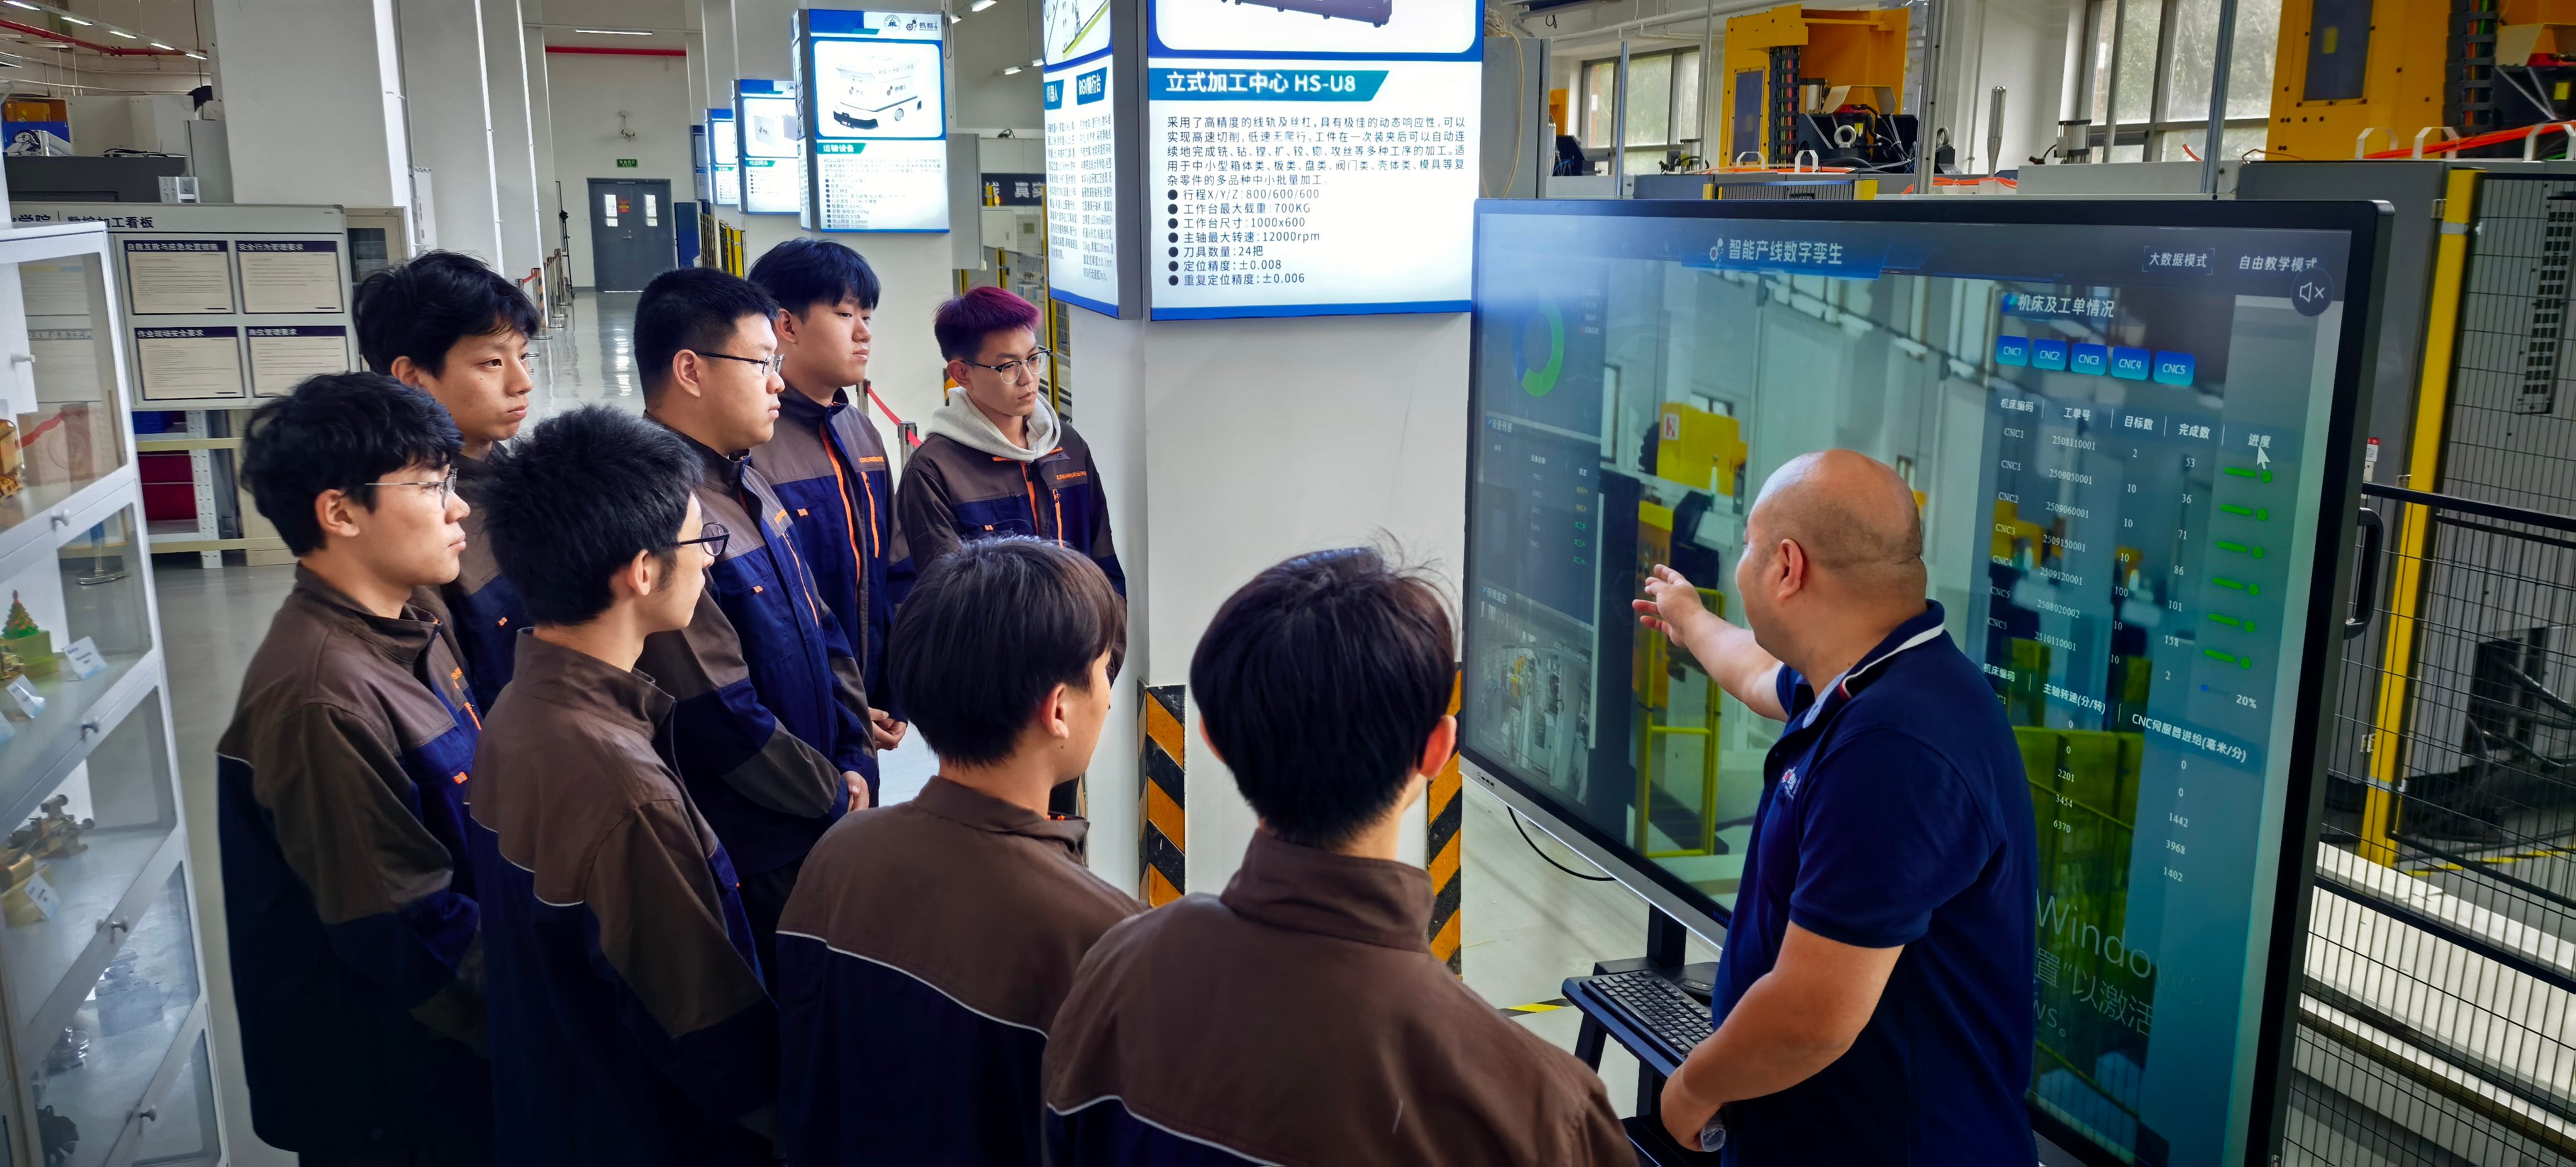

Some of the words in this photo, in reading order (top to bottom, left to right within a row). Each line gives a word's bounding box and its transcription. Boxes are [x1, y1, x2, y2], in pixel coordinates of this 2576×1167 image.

[1166, 72, 1289, 93] 立式加工中心
[1295, 75, 1356, 92] HS-U8
[1729, 238, 1843, 265] 智能产线数字孪生
[2148, 252, 2208, 268] 大数据模式
[2239, 255, 2318, 272] 自由教学模式
[2018, 293, 2115, 318] 机床及工单情况
[2003, 346, 2021, 357] CNC1
[2040, 350, 2060, 361] CNC2
[2078, 353, 2099, 365] CNC3
[2118, 358, 2142, 370] CNC4
[2162, 363, 2186, 375] CNC5
[2063, 407, 2091, 421] 工单号
[2124, 415, 2154, 431] 目标数
[2178, 423, 2211, 440] 完成数
[2248, 433, 2272, 448] 进度
[2133, 448, 2138, 458] 2
[2185, 457, 2196, 468] 53
[2127, 484, 2137, 493] 10
[2182, 494, 2192, 504] 36
[2124, 518, 2133, 528] 10
[2178, 529, 2187, 540] 71
[2120, 553, 2129, 563] 10
[2174, 565, 2184, 575] 86
[2114, 586, 2128, 597] 100
[2168, 600, 2183, 612] 101
[2114, 621, 2123, 630] 10
[2165, 634, 2180, 647] 158
[2111, 654, 2119, 664] 10
[2165, 671, 2171, 680] 2
[2236, 694, 2257, 709] 20%
[2068, 720, 2074, 729] 0
[2181, 760, 2187, 770] 0
[2066, 746, 2071, 755] 0
[2179, 787, 2184, 797] 0
[2057, 768, 2075, 783] 2201
[2169, 812, 2189, 828] 1442
[2053, 819, 2070, 834] 6370
[2055, 794, 2073, 809] 3454
[2165, 839, 2185, 855] 3968
